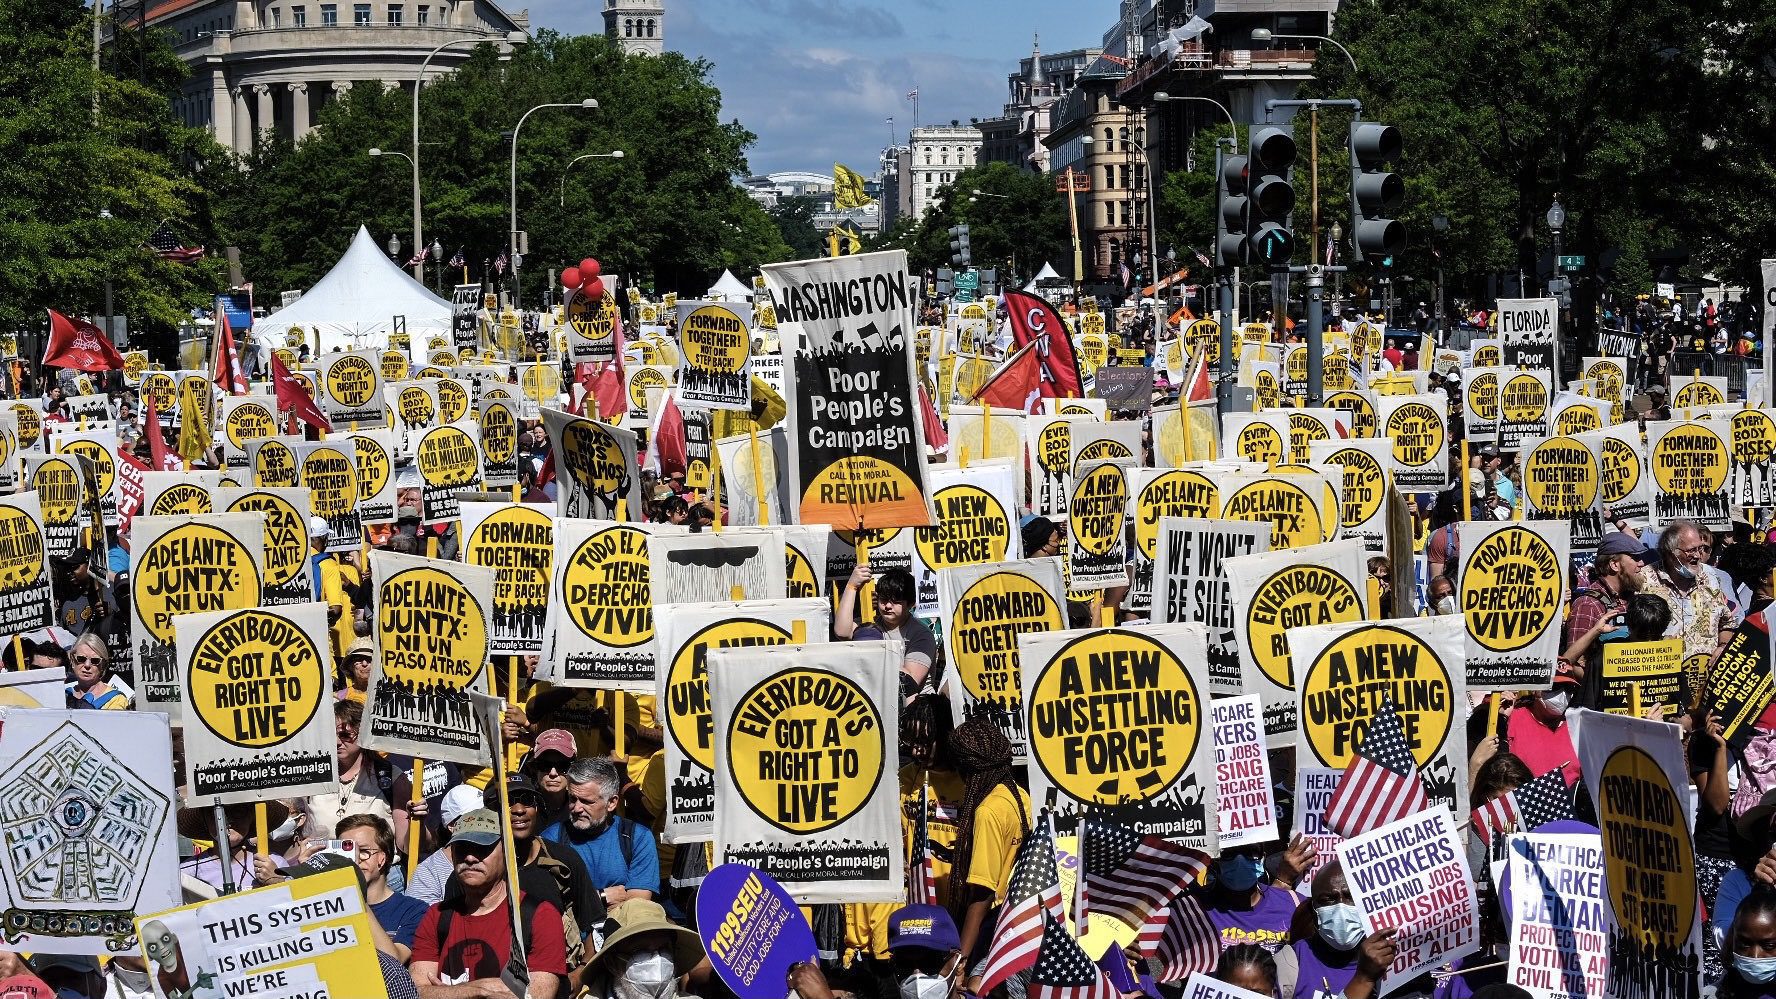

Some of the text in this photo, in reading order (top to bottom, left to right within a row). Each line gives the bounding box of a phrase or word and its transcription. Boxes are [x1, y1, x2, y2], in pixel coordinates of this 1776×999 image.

[768, 270, 907, 323] WASHINGTON
[578, 323, 610, 335] VIVIR
[690, 315, 740, 332] FORWARD
[1503, 309, 1550, 332] FLORIDA
[687, 330, 741, 347] TOGETHER!
[700, 345, 727, 356] NOT ONE
[1598, 333, 1637, 358] NATIONAL
[696, 354, 734, 368] STEP BACK!
[1518, 351, 1543, 365] Poor
[828, 368, 880, 392] Poor
[698, 393, 720, 402] People's
[811, 392, 904, 425] People's
[1389, 405, 1439, 431] EVERYBODY'S
[1403, 422, 1427, 434] GOT A
[424, 434, 465, 451] WE ARE THE
[809, 424, 910, 453] Campaign
[1396, 434, 1434, 447] RIGHT TO
[1663, 435, 1717, 451] FORWARD
[420, 446, 476, 468] 140 MILLION
[1404, 447, 1427, 462] LIVE
[1659, 452, 1718, 468] TOGETHER!
[830, 472, 846, 480] CALL
[864, 470, 891, 479] MORAL
[1084, 474, 1120, 496] A NEW
[1669, 478, 1712, 488] STEP BACK!
[1674, 468, 1704, 478] NOT ONE
[821, 481, 905, 504] REVIVAL
[1073, 497, 1124, 518] UNSETTLING
[1082, 517, 1116, 538] FORCE
[146, 537, 236, 572] ADELANTE
[1169, 529, 1192, 576] WE
[1473, 532, 1555, 580] TODO EL MUNDO
[147, 567, 239, 595] JUNTX:
[1493, 563, 1537, 586] TIENE
[166, 593, 224, 611] NI UN
[382, 581, 467, 616] ADELANTE
[1466, 587, 1554, 610] DERECHOS A
[383, 609, 468, 641] JUNTX:
[1472, 610, 1544, 640] VIVIR
[196, 616, 311, 674] EVERYBODY'S
[396, 635, 451, 658] NI UN
[1621, 648, 1654, 656] BILLIONAIRE
[227, 652, 285, 680] GOT A
[384, 650, 472, 676] PASO ATRAS
[1329, 644, 1419, 688] A NEW
[1607, 657, 1640, 665] INCREASED
[1710, 633, 1747, 684] FROM THE
[1059, 650, 1161, 698] A NEW
[1478, 668, 1550, 678] People's Campaign
[1713, 653, 1747, 695] BOTTOM
[1714, 650, 1761, 710] EVERYBODY
[147, 686, 170, 696] Poor
[215, 677, 300, 708] RIGHT TO
[1735, 673, 1761, 702] RISES
[737, 676, 873, 739] EVERYBODY'S
[1035, 690, 1192, 739] UNSETTLING
[233, 705, 287, 741] LIVE
[373, 719, 479, 744] Poor People's Campaign
[775, 718, 840, 749] GOT A
[1064, 727, 1166, 775] FORCE
[198, 761, 331, 785] Poor People's Campaign
[759, 749, 858, 781] RIGHT TO
[777, 782, 839, 823] LIVE
[1134, 818, 1202, 835] Campaign
[1345, 815, 1446, 869] HEALTHCARE
[768, 854, 887, 870] People's Campaign
[815, 870, 838, 878] MORAL
[840, 869, 864, 877] REVIVAL
[1352, 837, 1455, 894] WORKERS
[1362, 862, 1462, 914] DEMAND JOBS
[711, 872, 762, 960] 1199SEIU
[1369, 880, 1469, 933] HOUSING
[203, 897, 344, 943] THIS SYSTEM
[724, 949, 737, 966] United
[735, 921, 753, 949] Healthcare
[749, 901, 764, 920] Workers
[735, 898, 781, 977] QUALITY CARE AND
[1429, 927, 1473, 958] ALL!
[1520, 924, 1601, 953] PROTECTION
[218, 928, 355, 973] IS KILLING US.
[743, 908, 789, 986] GOOD JOBS FOR ALL
[1519, 945, 1580, 970] VOTING
[225, 971, 288, 997] WE'RE
[1516, 966, 1554, 990] CIVIL
